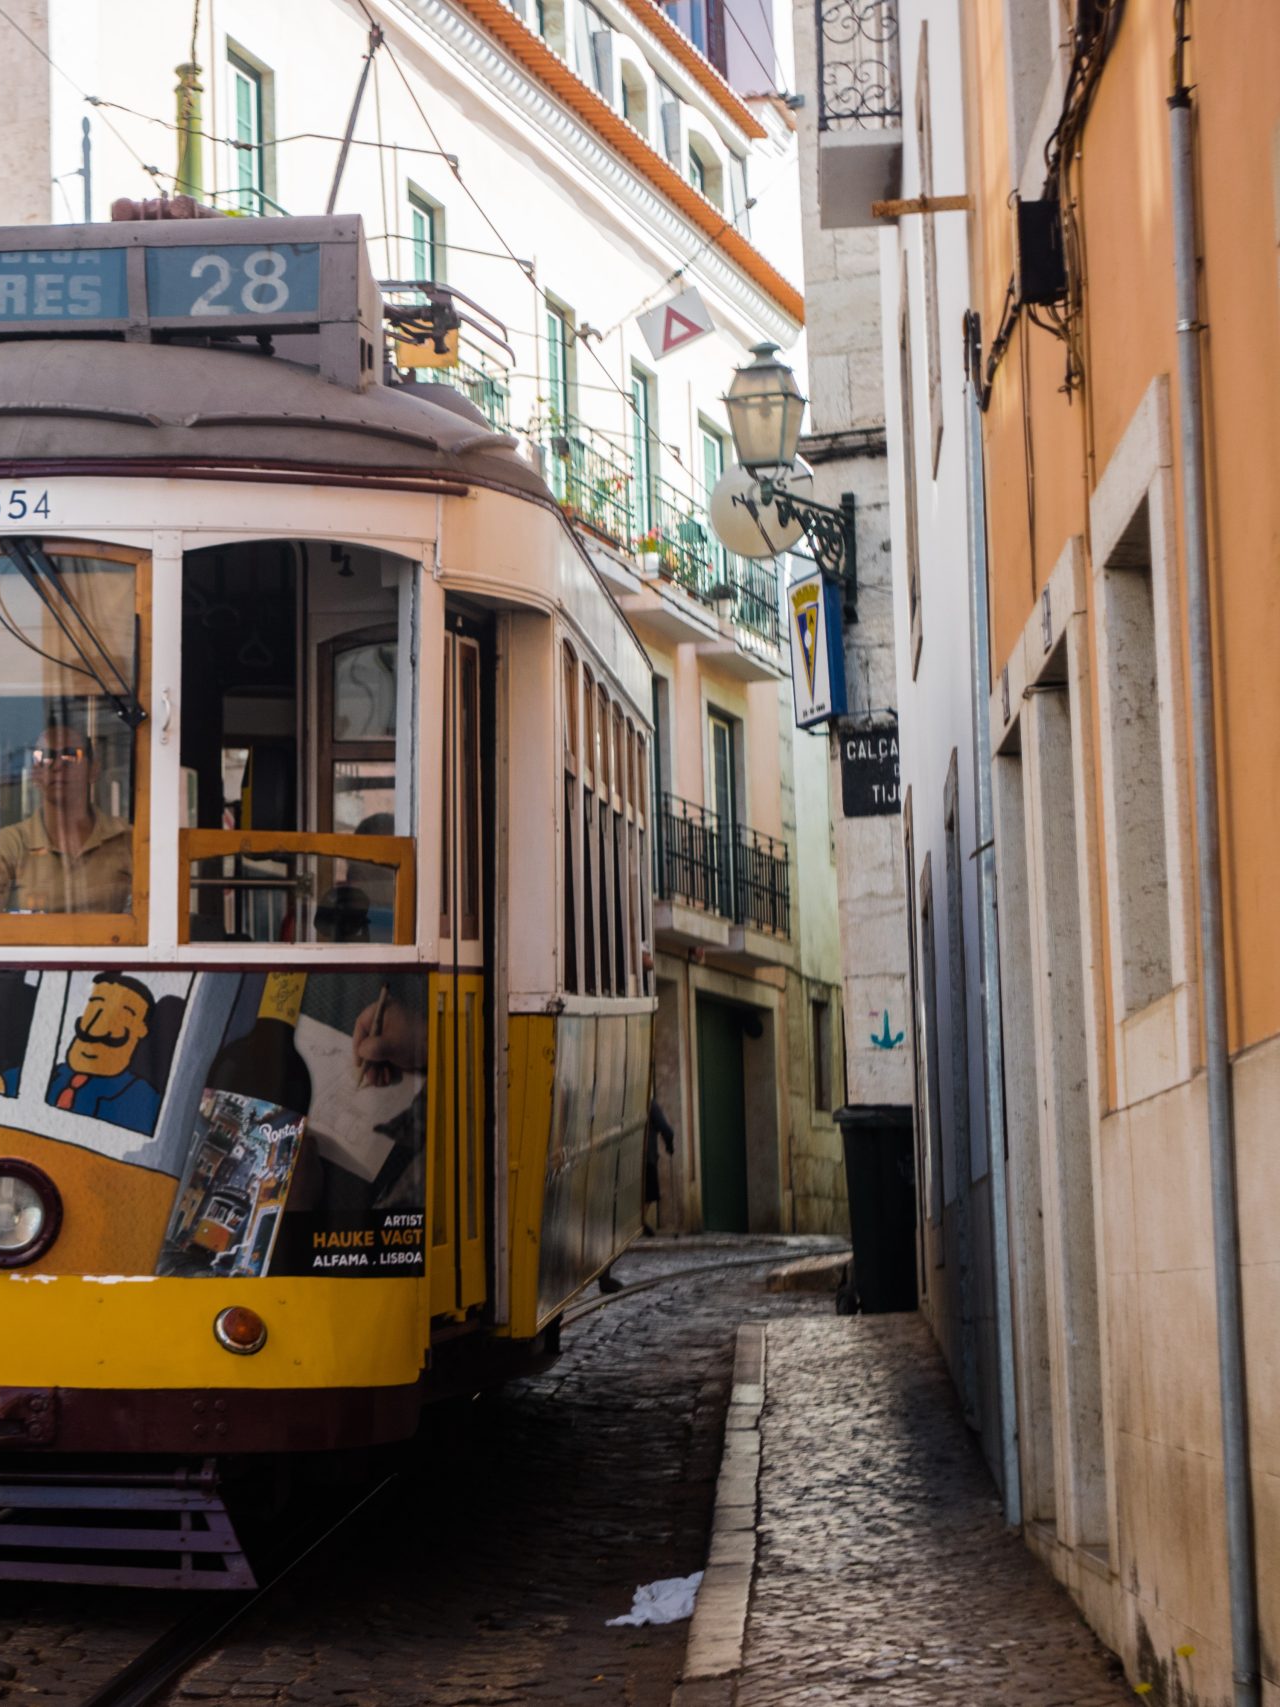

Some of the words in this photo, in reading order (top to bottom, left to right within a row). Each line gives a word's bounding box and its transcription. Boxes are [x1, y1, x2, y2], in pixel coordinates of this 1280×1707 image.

[190, 250, 289, 316] 28
[384, 1214, 423, 1227] ARTIST
[313, 1230, 375, 1248] HAUKE
[381, 1228, 423, 1245] VAGT
[312, 1253, 368, 1267] ALFAMA
[380, 1251, 423, 1265] LISBOA
